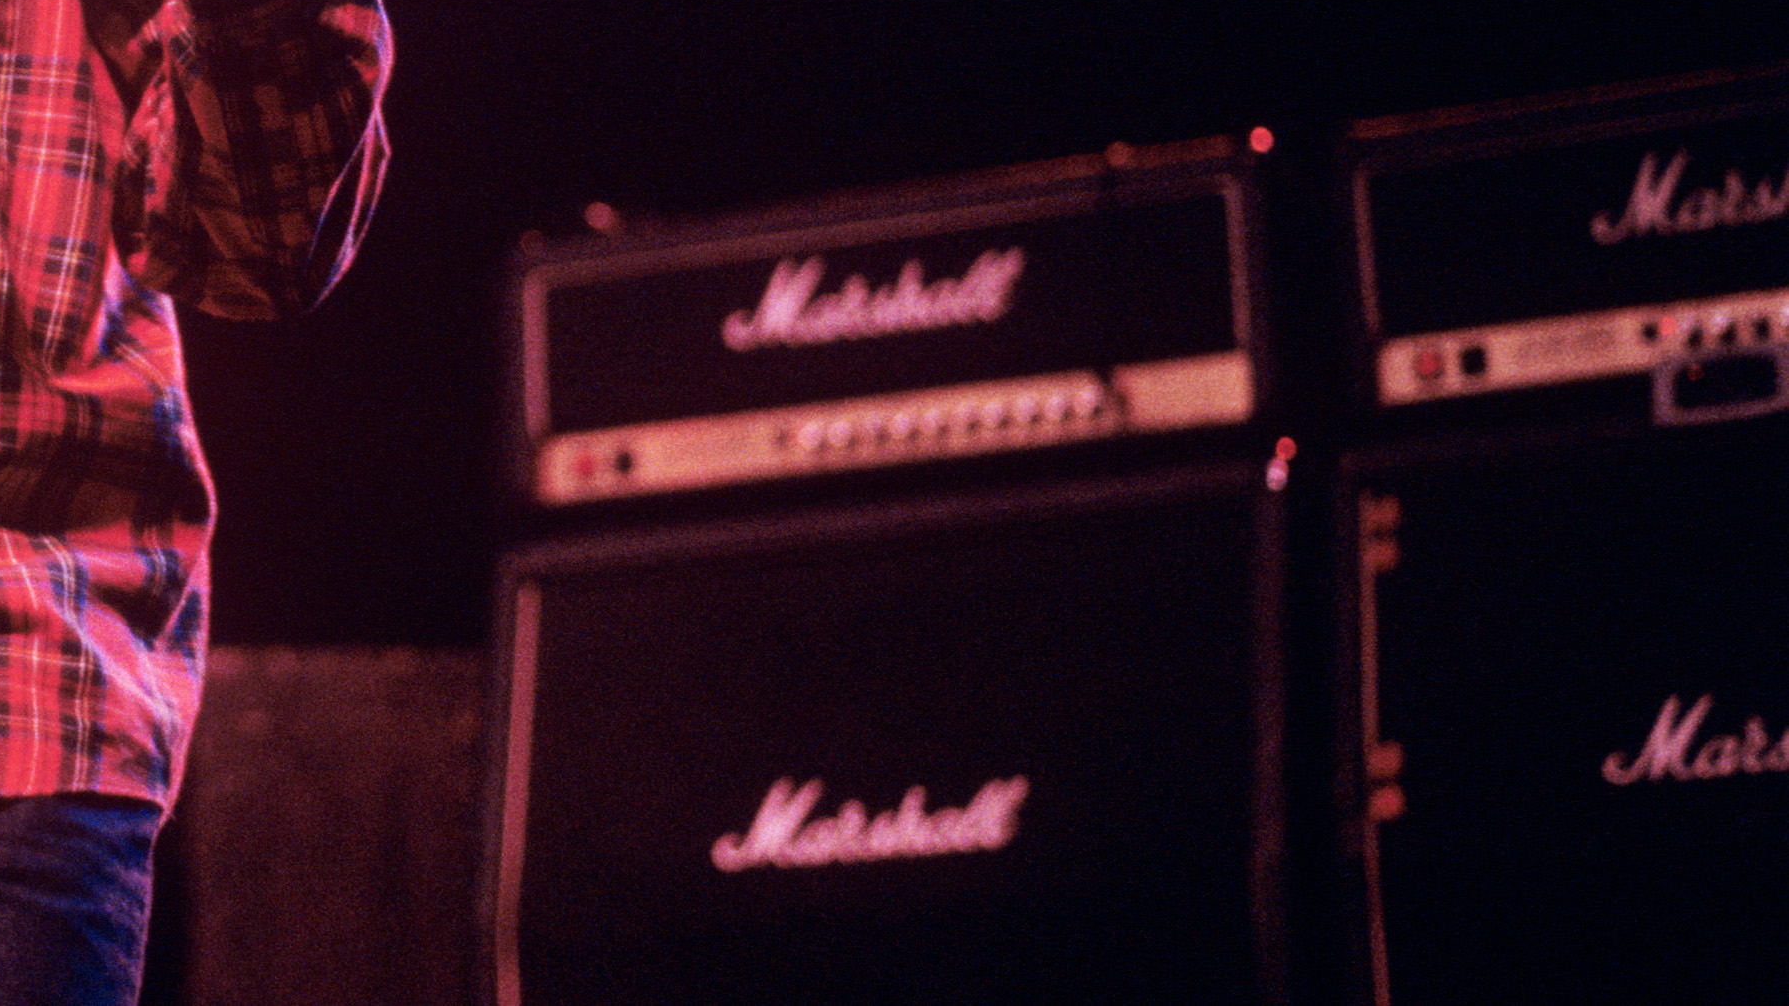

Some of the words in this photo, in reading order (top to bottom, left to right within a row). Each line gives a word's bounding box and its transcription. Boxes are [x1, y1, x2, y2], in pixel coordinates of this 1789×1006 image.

[1590, 148, 1789, 245] Mars
[722, 247, 1026, 352] Marshall
[712, 775, 1030, 872] Marshall
